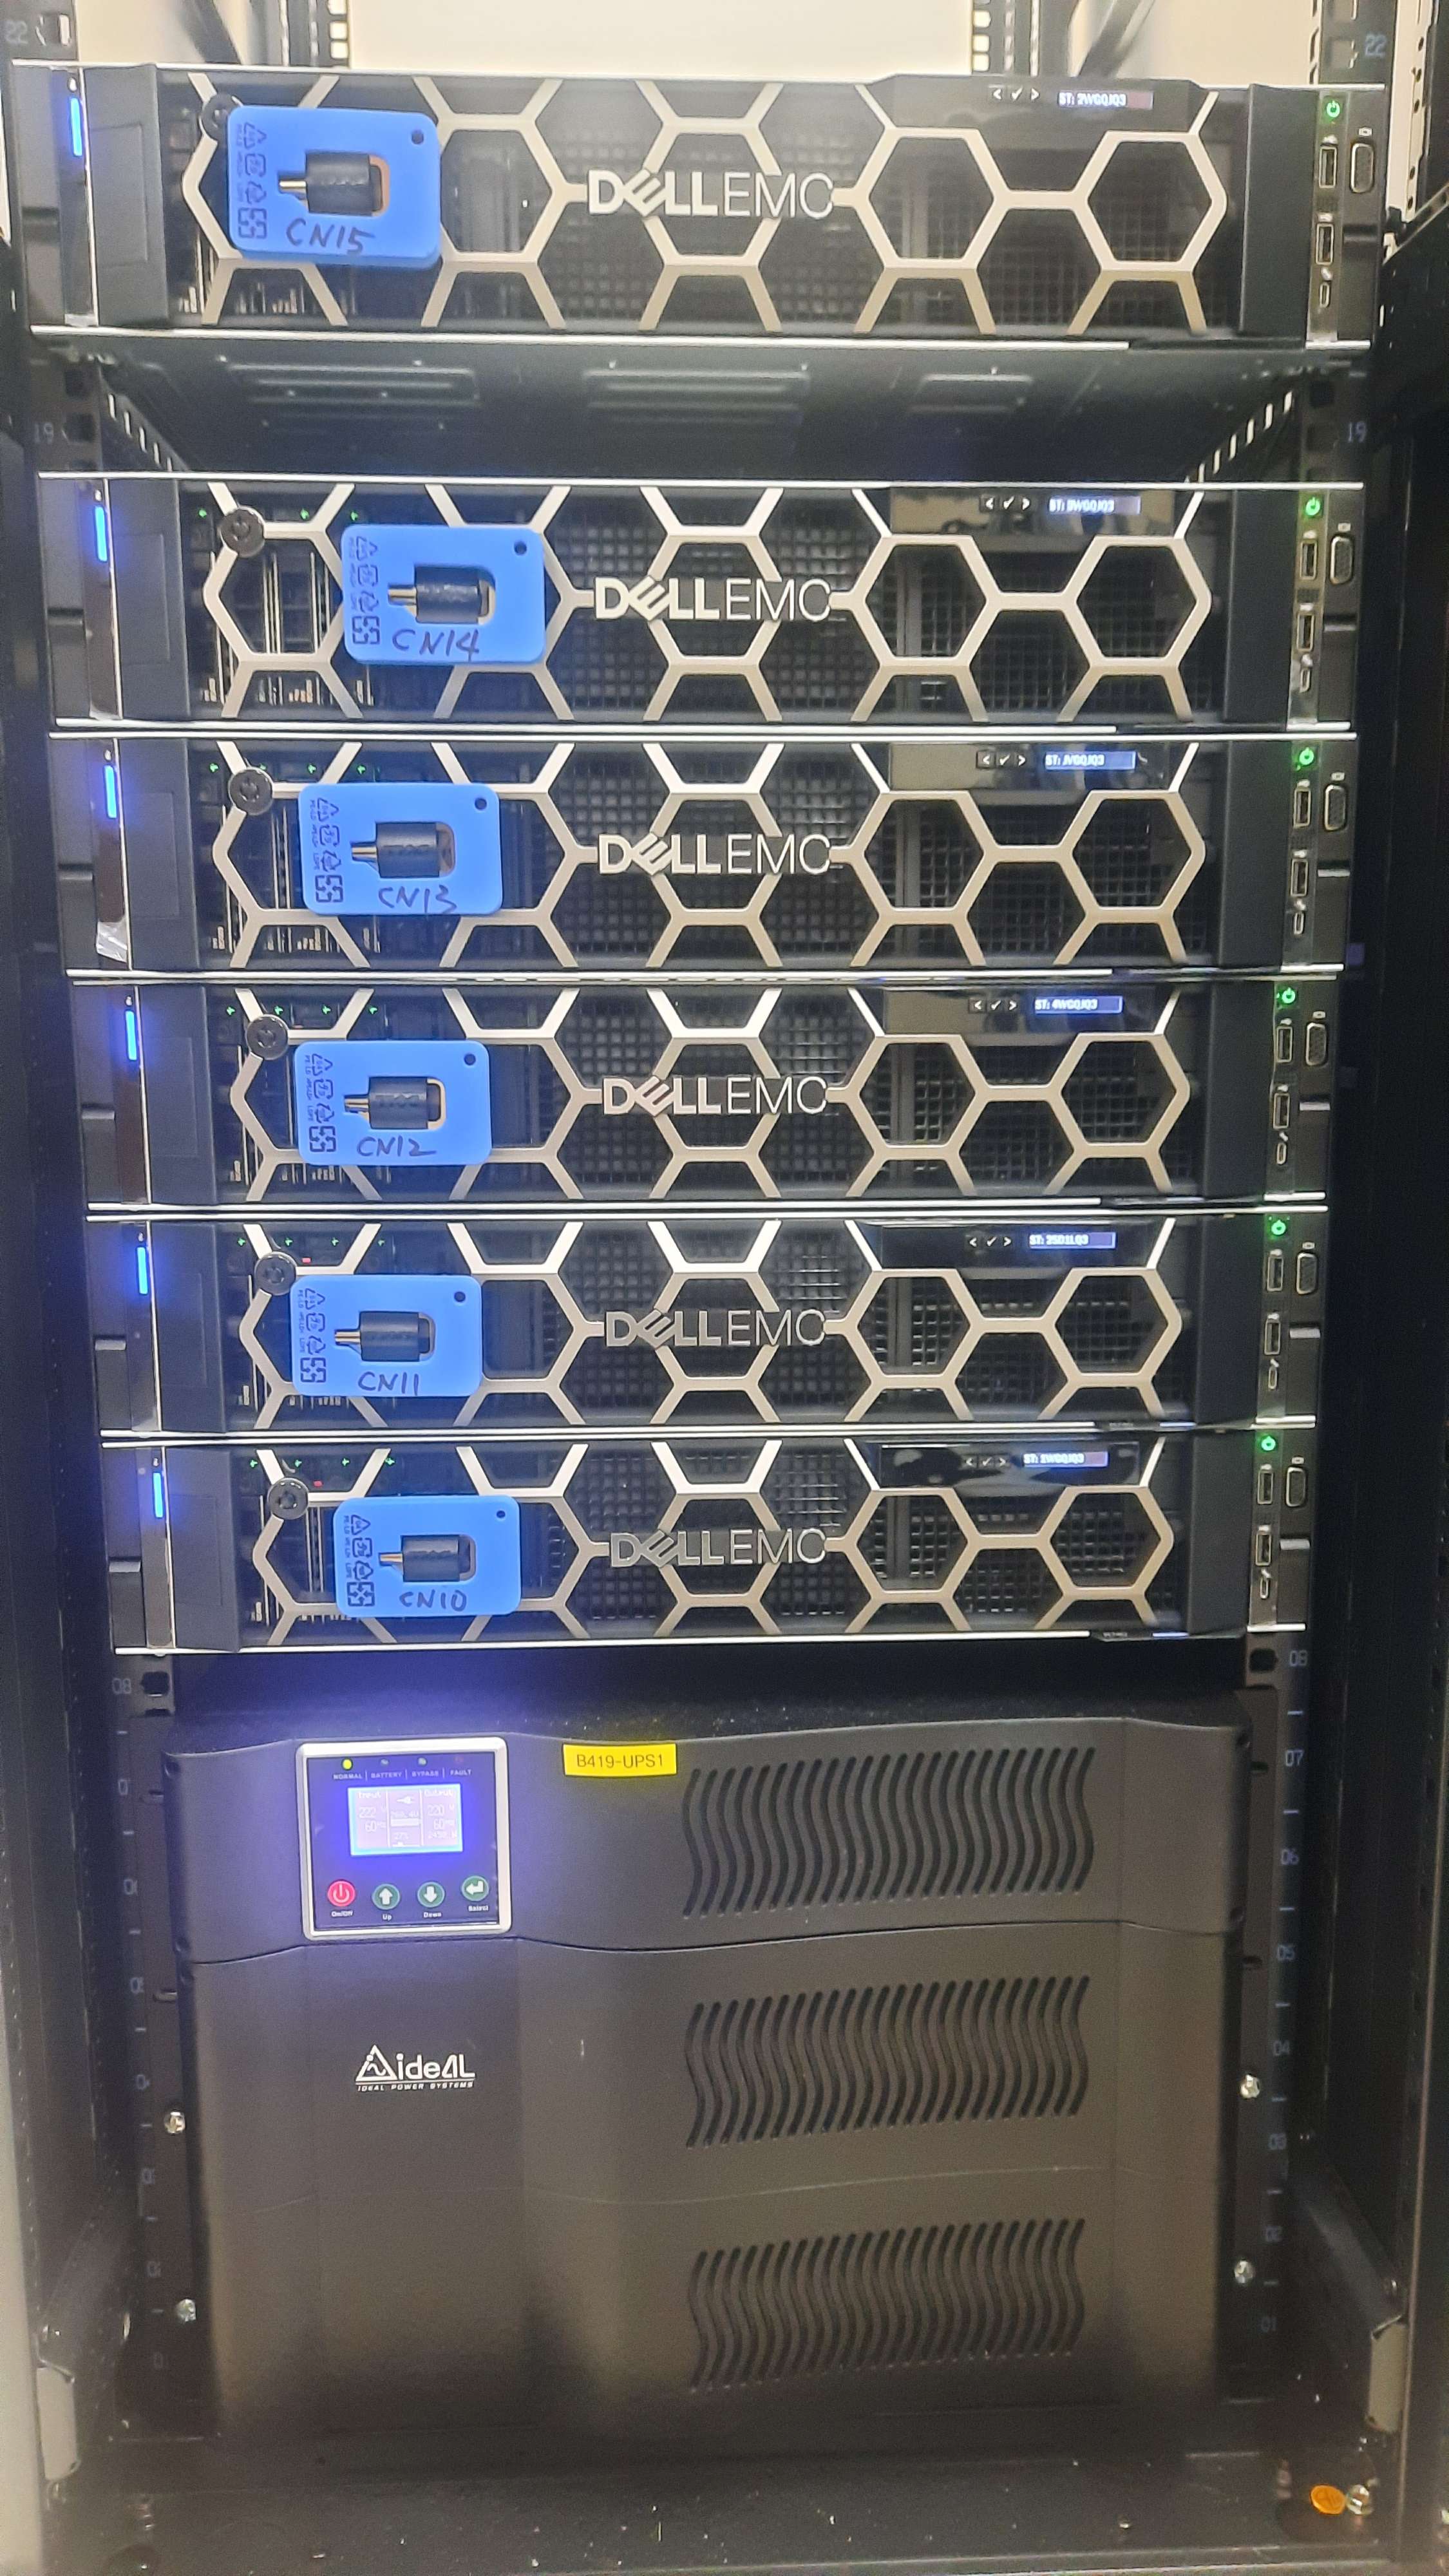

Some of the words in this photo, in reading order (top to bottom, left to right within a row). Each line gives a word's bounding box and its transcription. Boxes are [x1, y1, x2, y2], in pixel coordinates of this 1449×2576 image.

[1365, 33, 1387, 58] 22
[285, 217, 377, 255] CN15
[35, 422, 54, 444] 19
[1348, 421, 1367, 443] 19
[392, 628, 480, 662] CN14
[378, 884, 457, 913] CN13
[357, 1135, 438, 1158] CN12
[357, 1371, 420, 1396] CN11
[399, 1589, 468, 1612] CN10
[1289, 1650, 1309, 1667] 08
[112, 1678, 133, 1696] 08
[576, 1754, 663, 1768] B419-UPS1
[1285, 1750, 1304, 1767] 07
[1281, 1848, 1300, 1866] 06
[1277, 1944, 1295, 1962] 05
[1273, 2040, 1291, 2057] 04
[430, 2081, 473, 2090] SYSTEMS
[1260, 2316, 1278, 2334] 01
